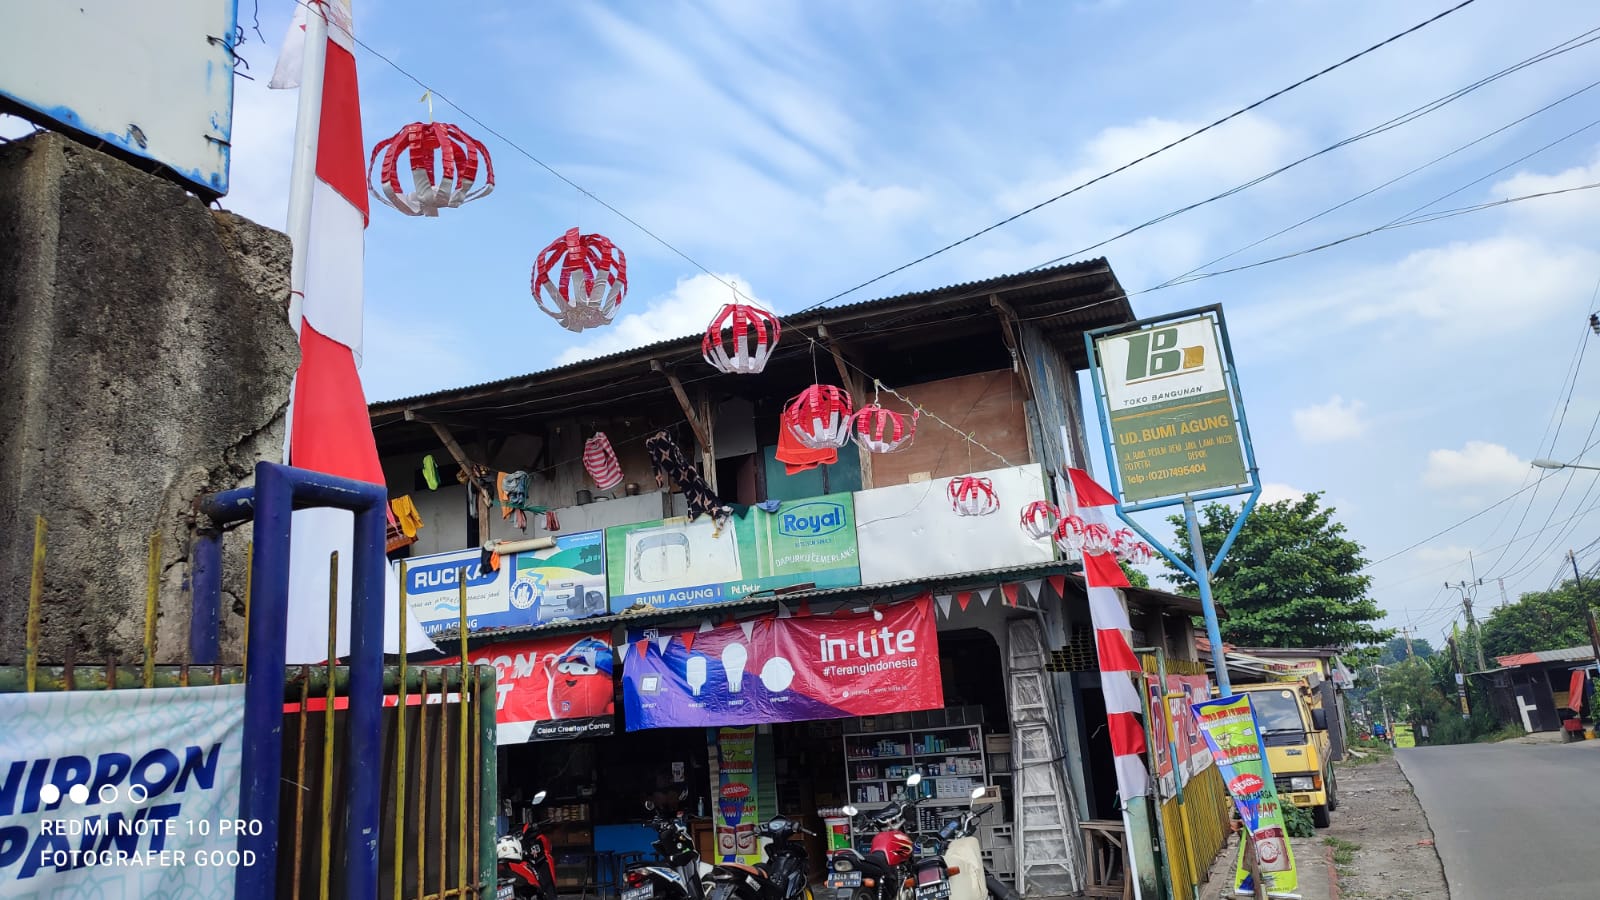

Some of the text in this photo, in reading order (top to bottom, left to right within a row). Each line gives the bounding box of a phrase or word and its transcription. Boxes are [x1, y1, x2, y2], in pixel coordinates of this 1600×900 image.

[1124, 386, 1203, 406] TOKO BANGUNAN
[1119, 415, 1229, 446] UD. BUMI AGUNG
[784, 507, 841, 533] Royal
[636, 594, 666, 606] BUMI
[668, 587, 714, 602] AGUNG
[823, 656, 918, 677] #TerangIndonesia
